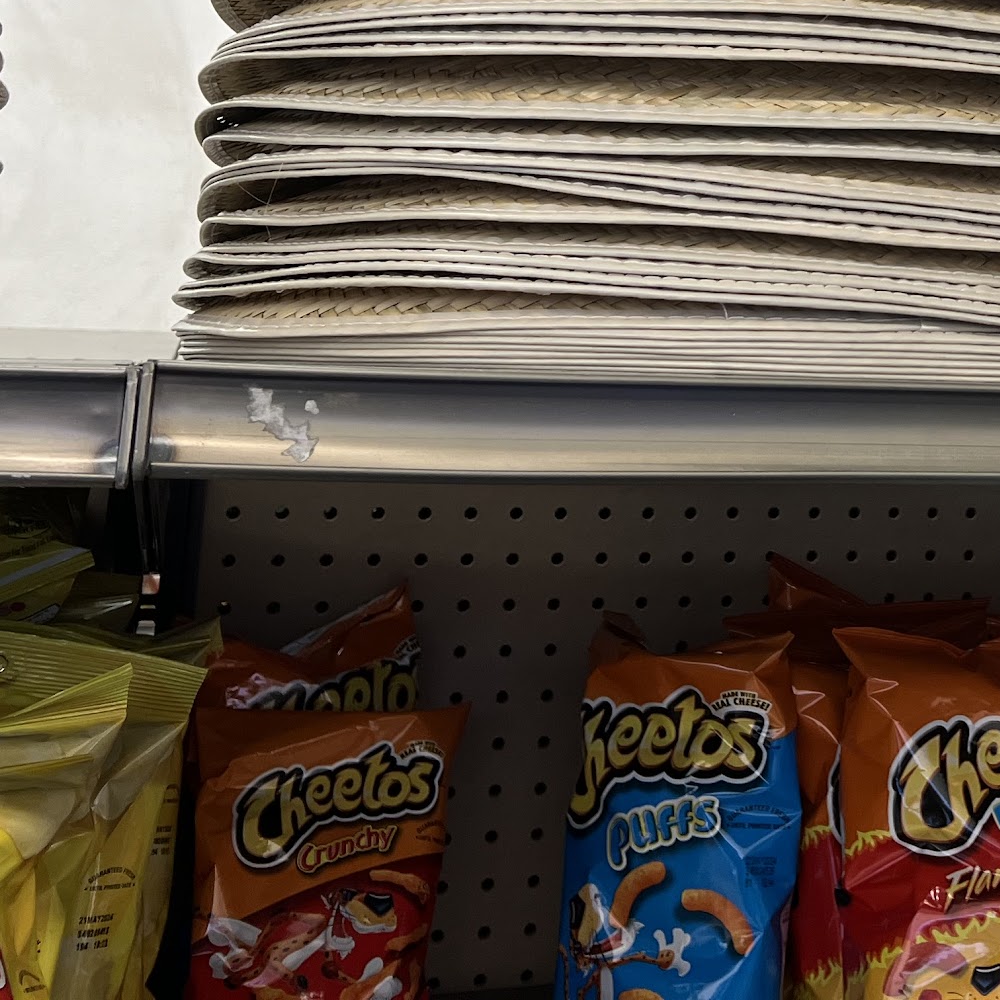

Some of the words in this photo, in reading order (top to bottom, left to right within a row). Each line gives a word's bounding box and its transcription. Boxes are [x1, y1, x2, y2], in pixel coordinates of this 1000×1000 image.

[733, 697, 770, 711] CHEESE!
[569, 692, 760, 816] heetos
[239, 746, 437, 861] Cheetos
[300, 826, 396, 871] Crunchy
